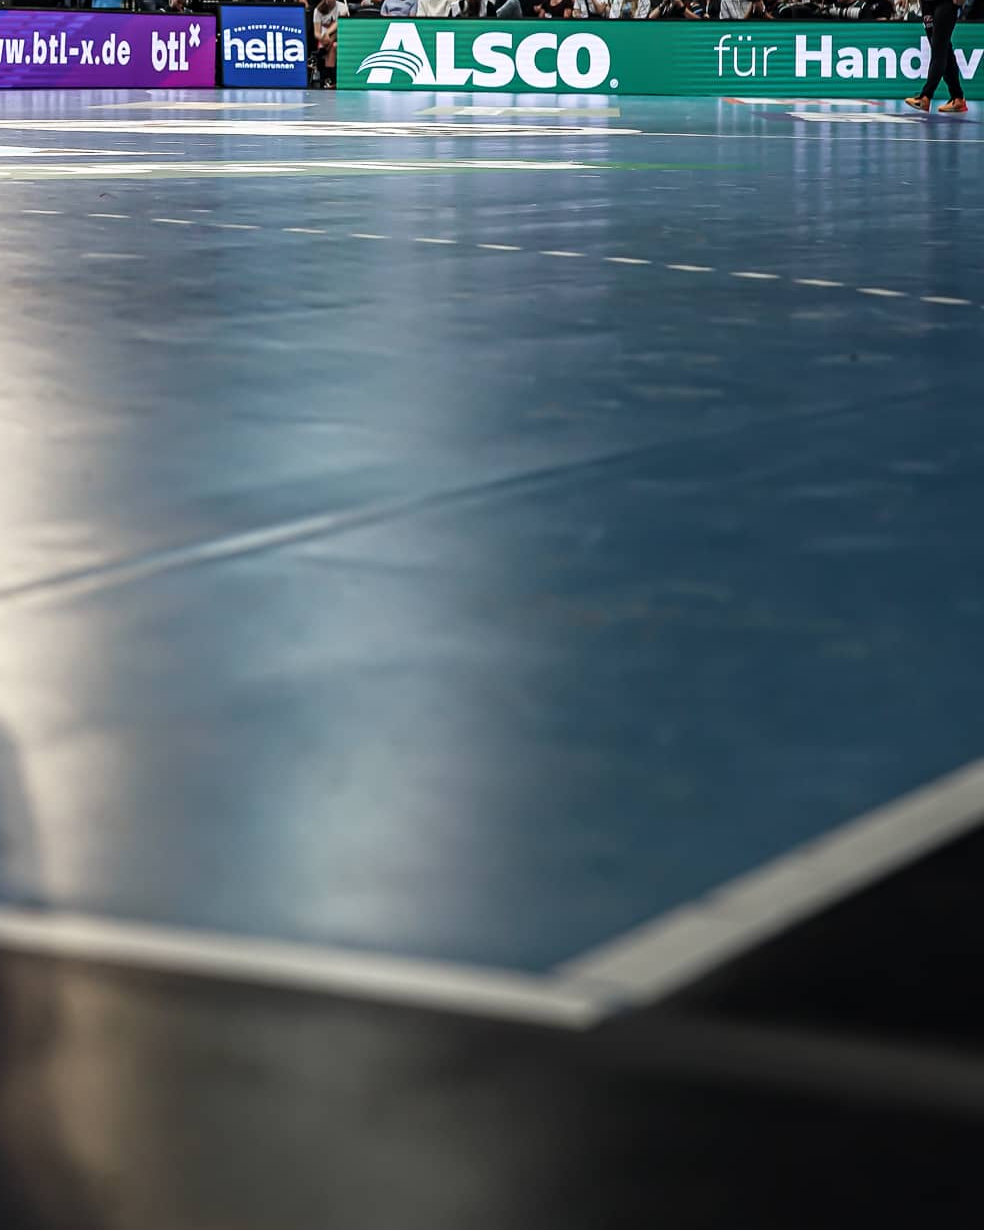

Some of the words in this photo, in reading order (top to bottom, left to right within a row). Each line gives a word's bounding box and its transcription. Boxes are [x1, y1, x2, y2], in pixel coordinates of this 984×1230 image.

[223, 29, 305, 62] hella
[356, 22, 612, 89] ALSCO
[714, 34, 778, 77] für
[234, 61, 295, 70] mineralbrunnen
